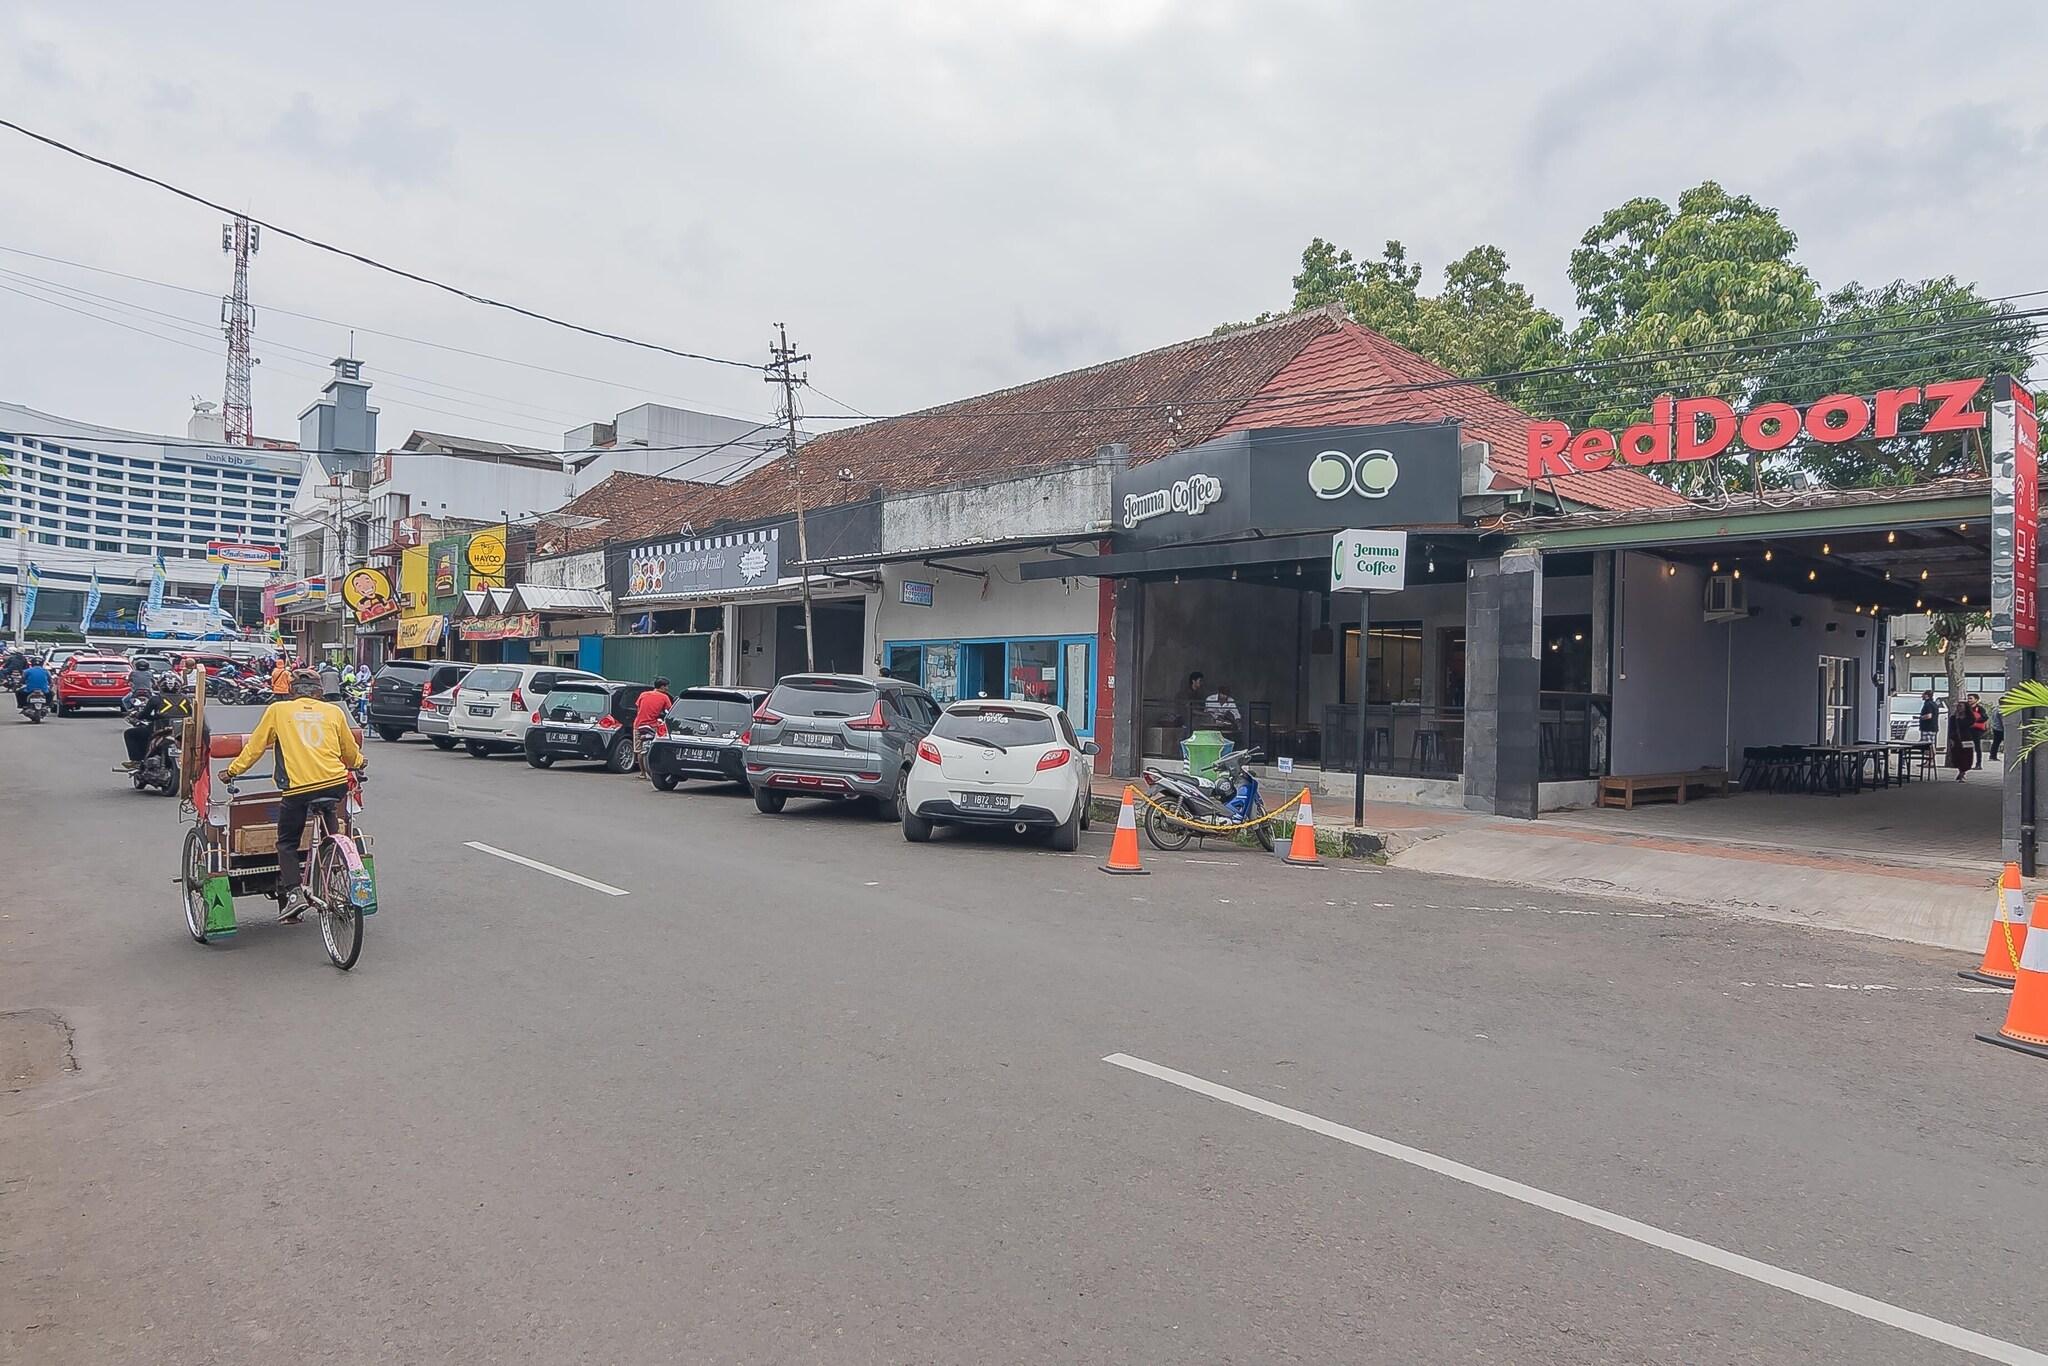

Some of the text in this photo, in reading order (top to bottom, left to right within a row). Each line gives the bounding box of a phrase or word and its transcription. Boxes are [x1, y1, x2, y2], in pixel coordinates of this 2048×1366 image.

[1528, 377, 1987, 479] RedDoorz
[206, 452, 243, 465] bank bjb
[1124, 476, 1216, 527] Jemma Coffee
[474, 554, 501, 563] HAYOO
[1353, 543, 1399, 576] Jemma Coffee
[793, 732, 799, 744] D
[803, 733, 818, 744] 1191
[962, 793, 1009, 806] D 1872 SGD
